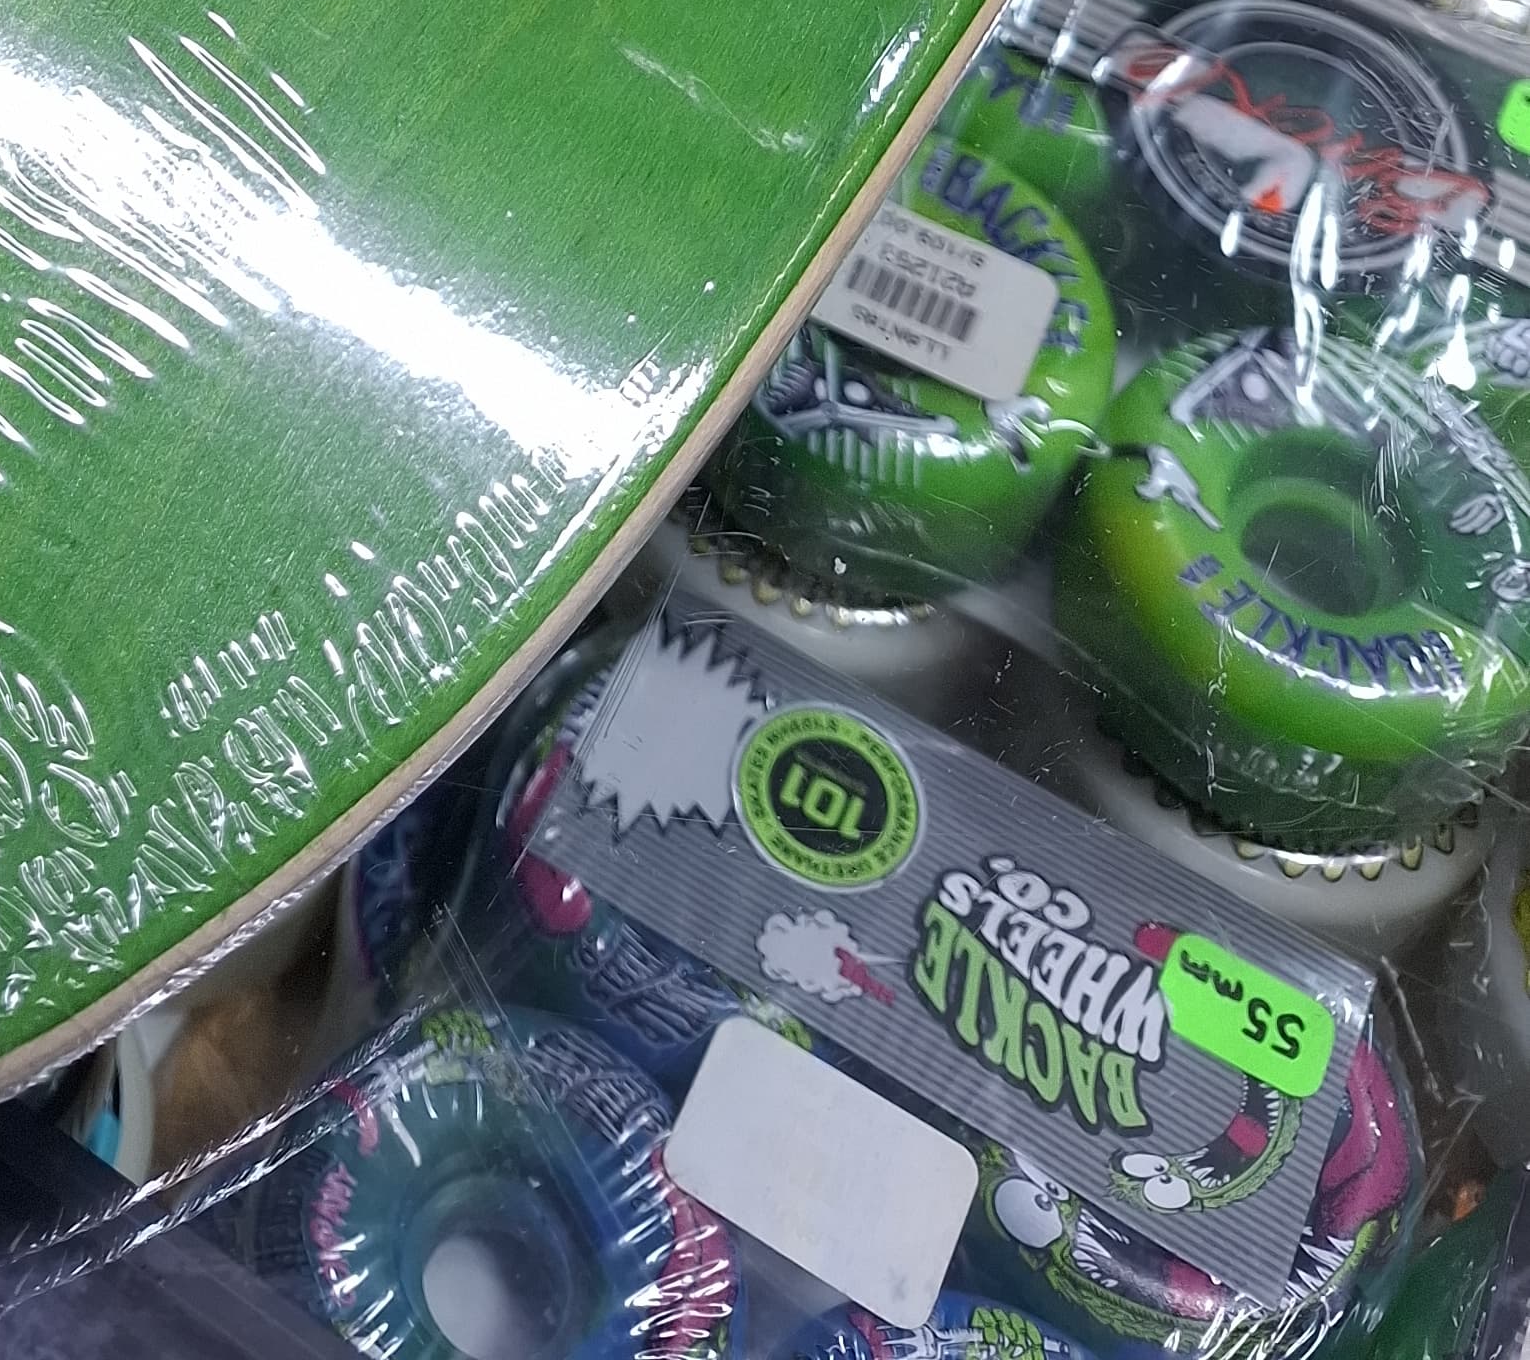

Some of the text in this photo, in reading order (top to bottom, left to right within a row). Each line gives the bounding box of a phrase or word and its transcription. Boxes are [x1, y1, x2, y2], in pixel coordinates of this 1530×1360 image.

[779, 762, 866, 840] 101
[913, 902, 1148, 1130] BACKLE
[938, 870, 1166, 1063] WHEELS
